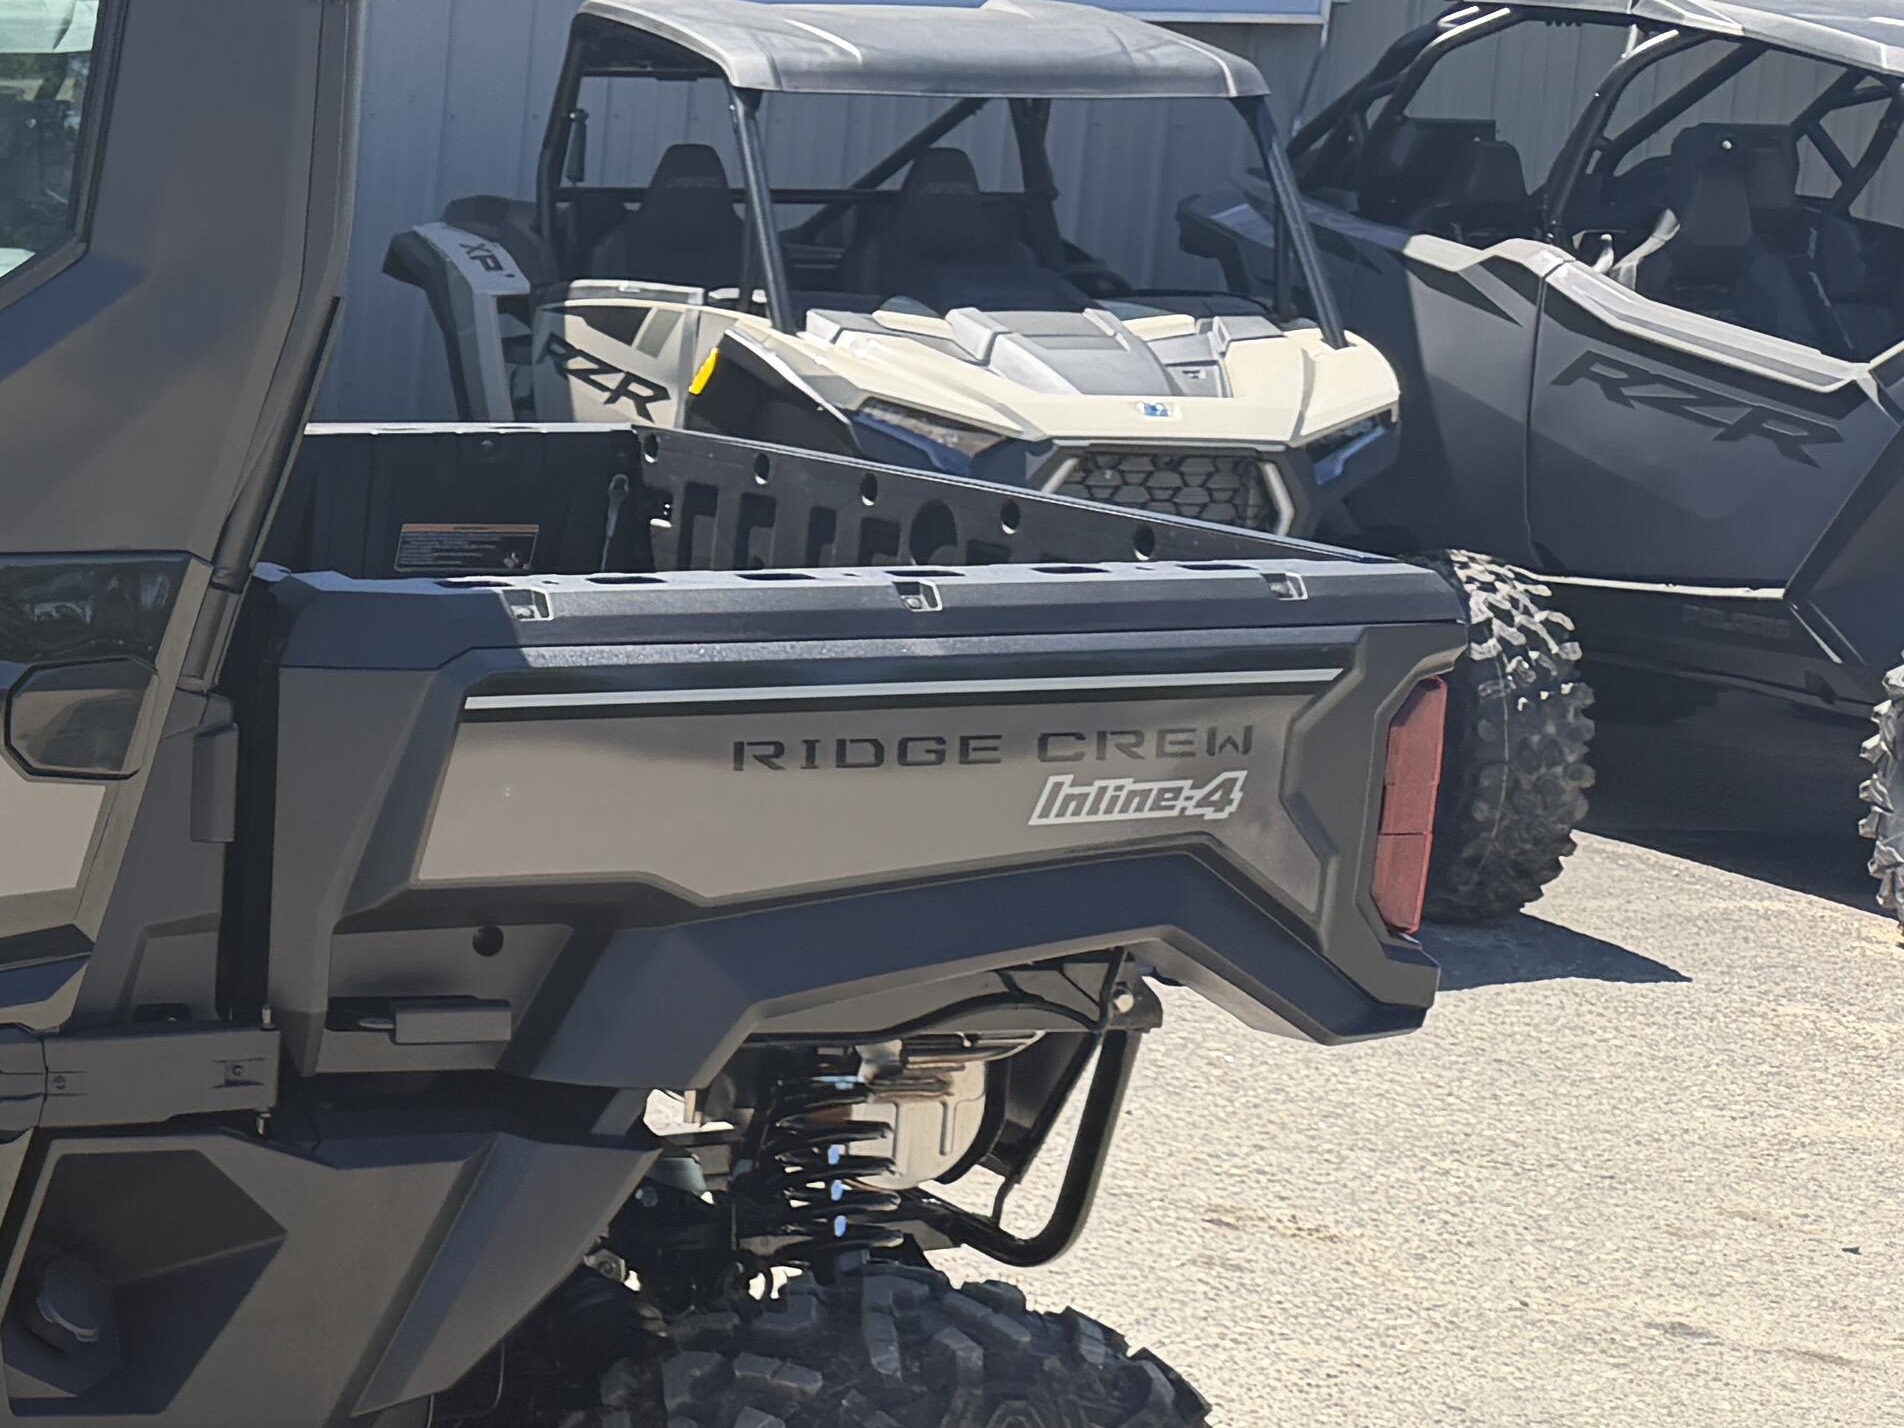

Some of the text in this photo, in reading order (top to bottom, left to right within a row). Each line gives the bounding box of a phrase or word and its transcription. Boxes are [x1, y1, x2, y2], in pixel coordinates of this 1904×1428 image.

[458, 242, 503, 272] XP
[533, 332, 672, 423] RZR
[1550, 350, 1844, 469] RZR
[732, 724, 1254, 772] RIDGE CREW
